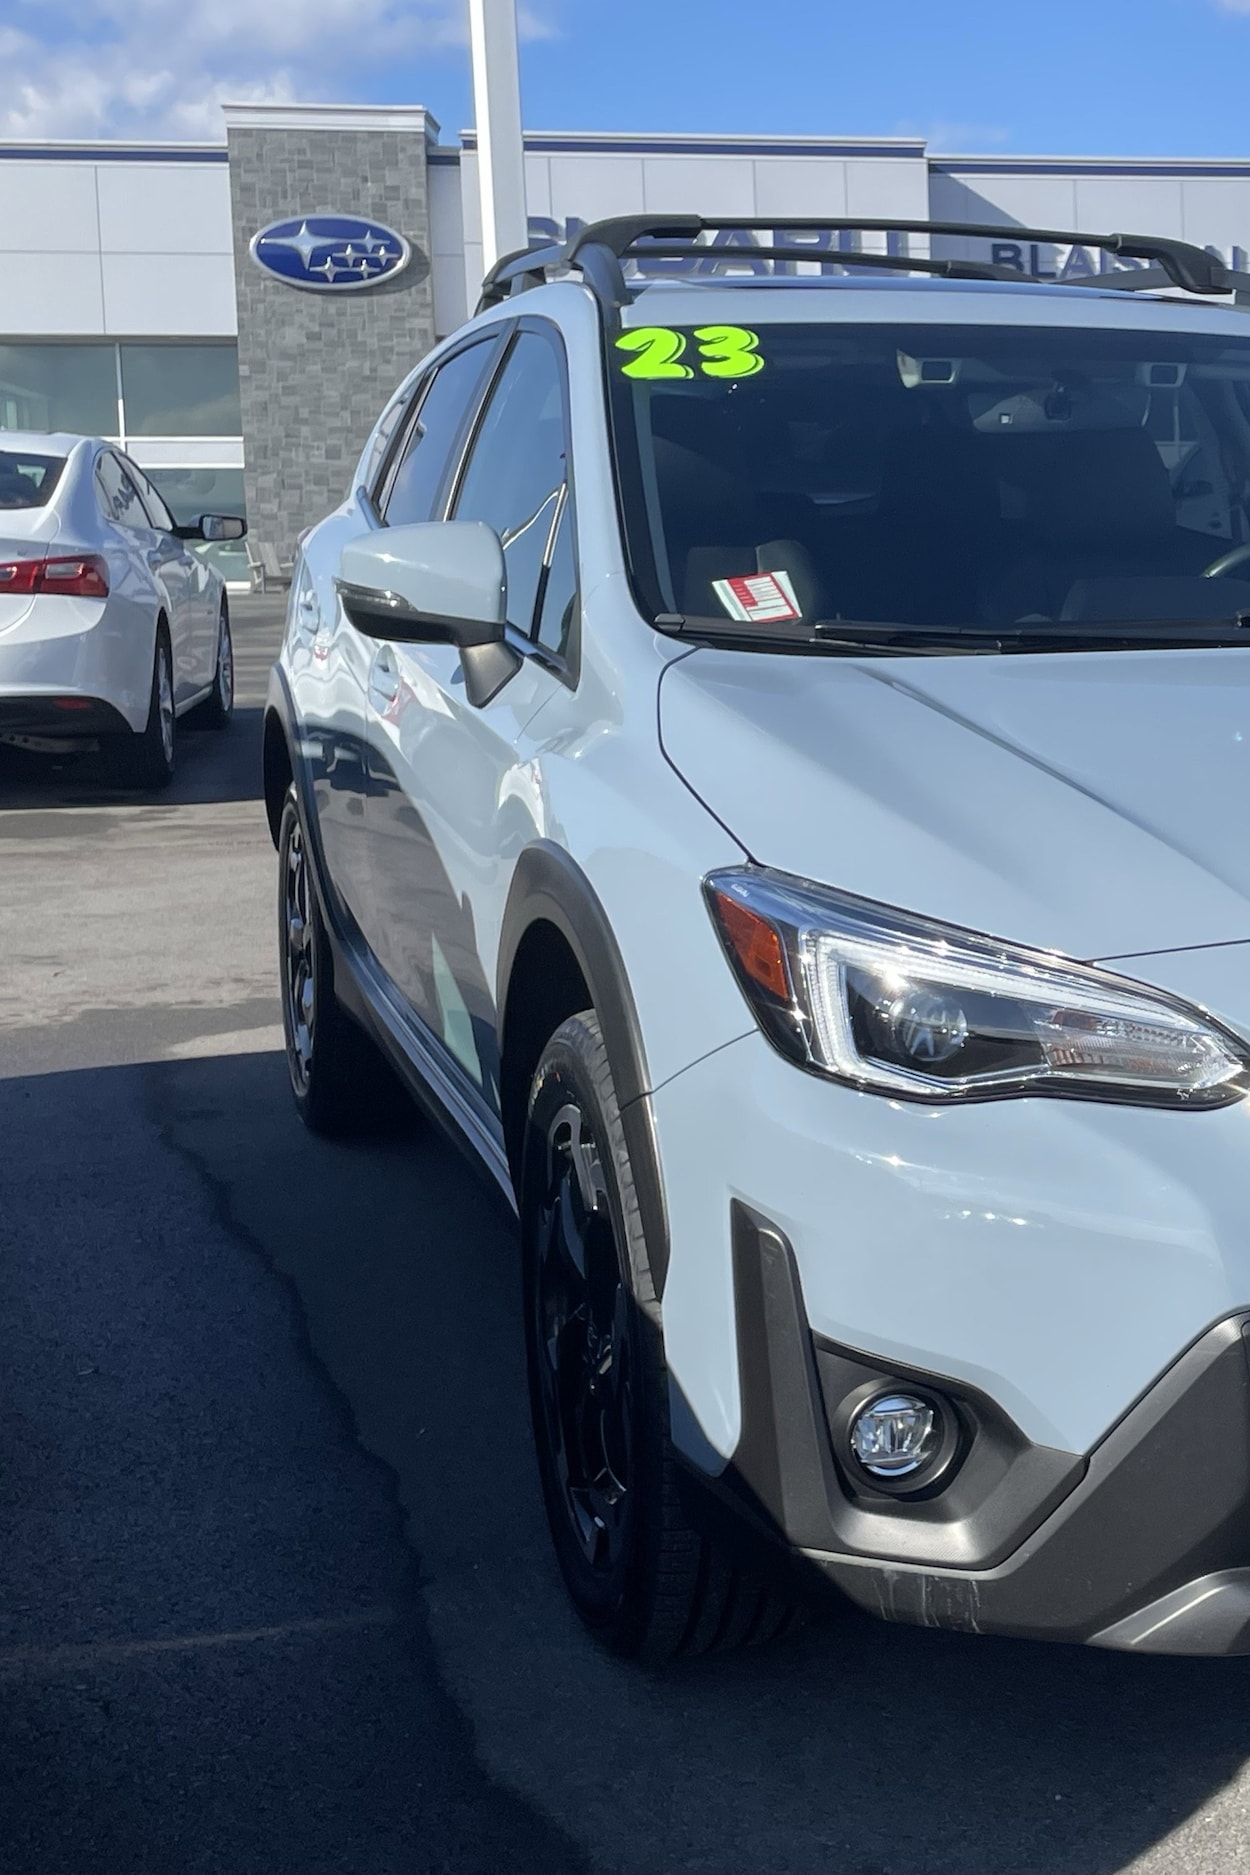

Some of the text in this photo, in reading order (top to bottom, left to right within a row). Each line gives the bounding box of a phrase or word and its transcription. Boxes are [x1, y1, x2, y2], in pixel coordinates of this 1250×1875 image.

[527, 216, 902, 277] BARU
[991, 243, 1160, 278] BLAIS
[614, 325, 765, 379] 23
